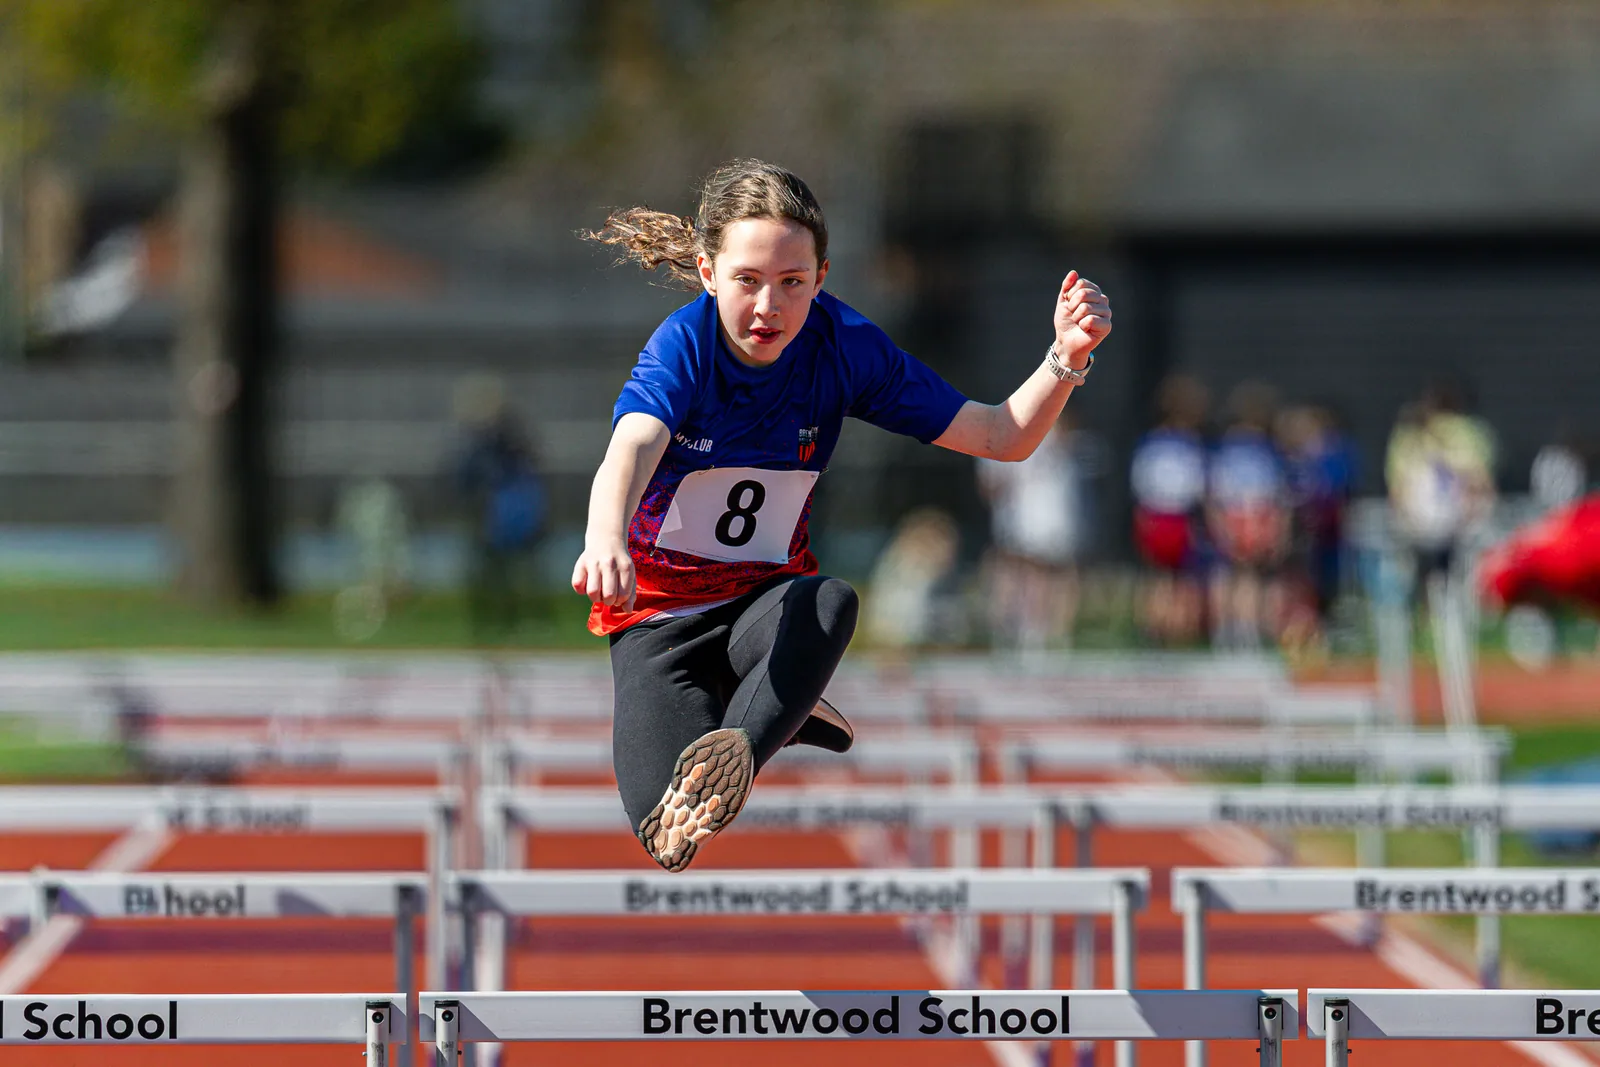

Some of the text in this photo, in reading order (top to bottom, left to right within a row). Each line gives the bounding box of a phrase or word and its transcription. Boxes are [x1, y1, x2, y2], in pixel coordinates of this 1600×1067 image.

[714, 479, 766, 547] 8
[624, 880, 968, 912] Brentwood School
[1355, 879, 1566, 911] Brentwood
[23, 1001, 178, 1040] School
[643, 996, 1070, 1035] Brentwood School
